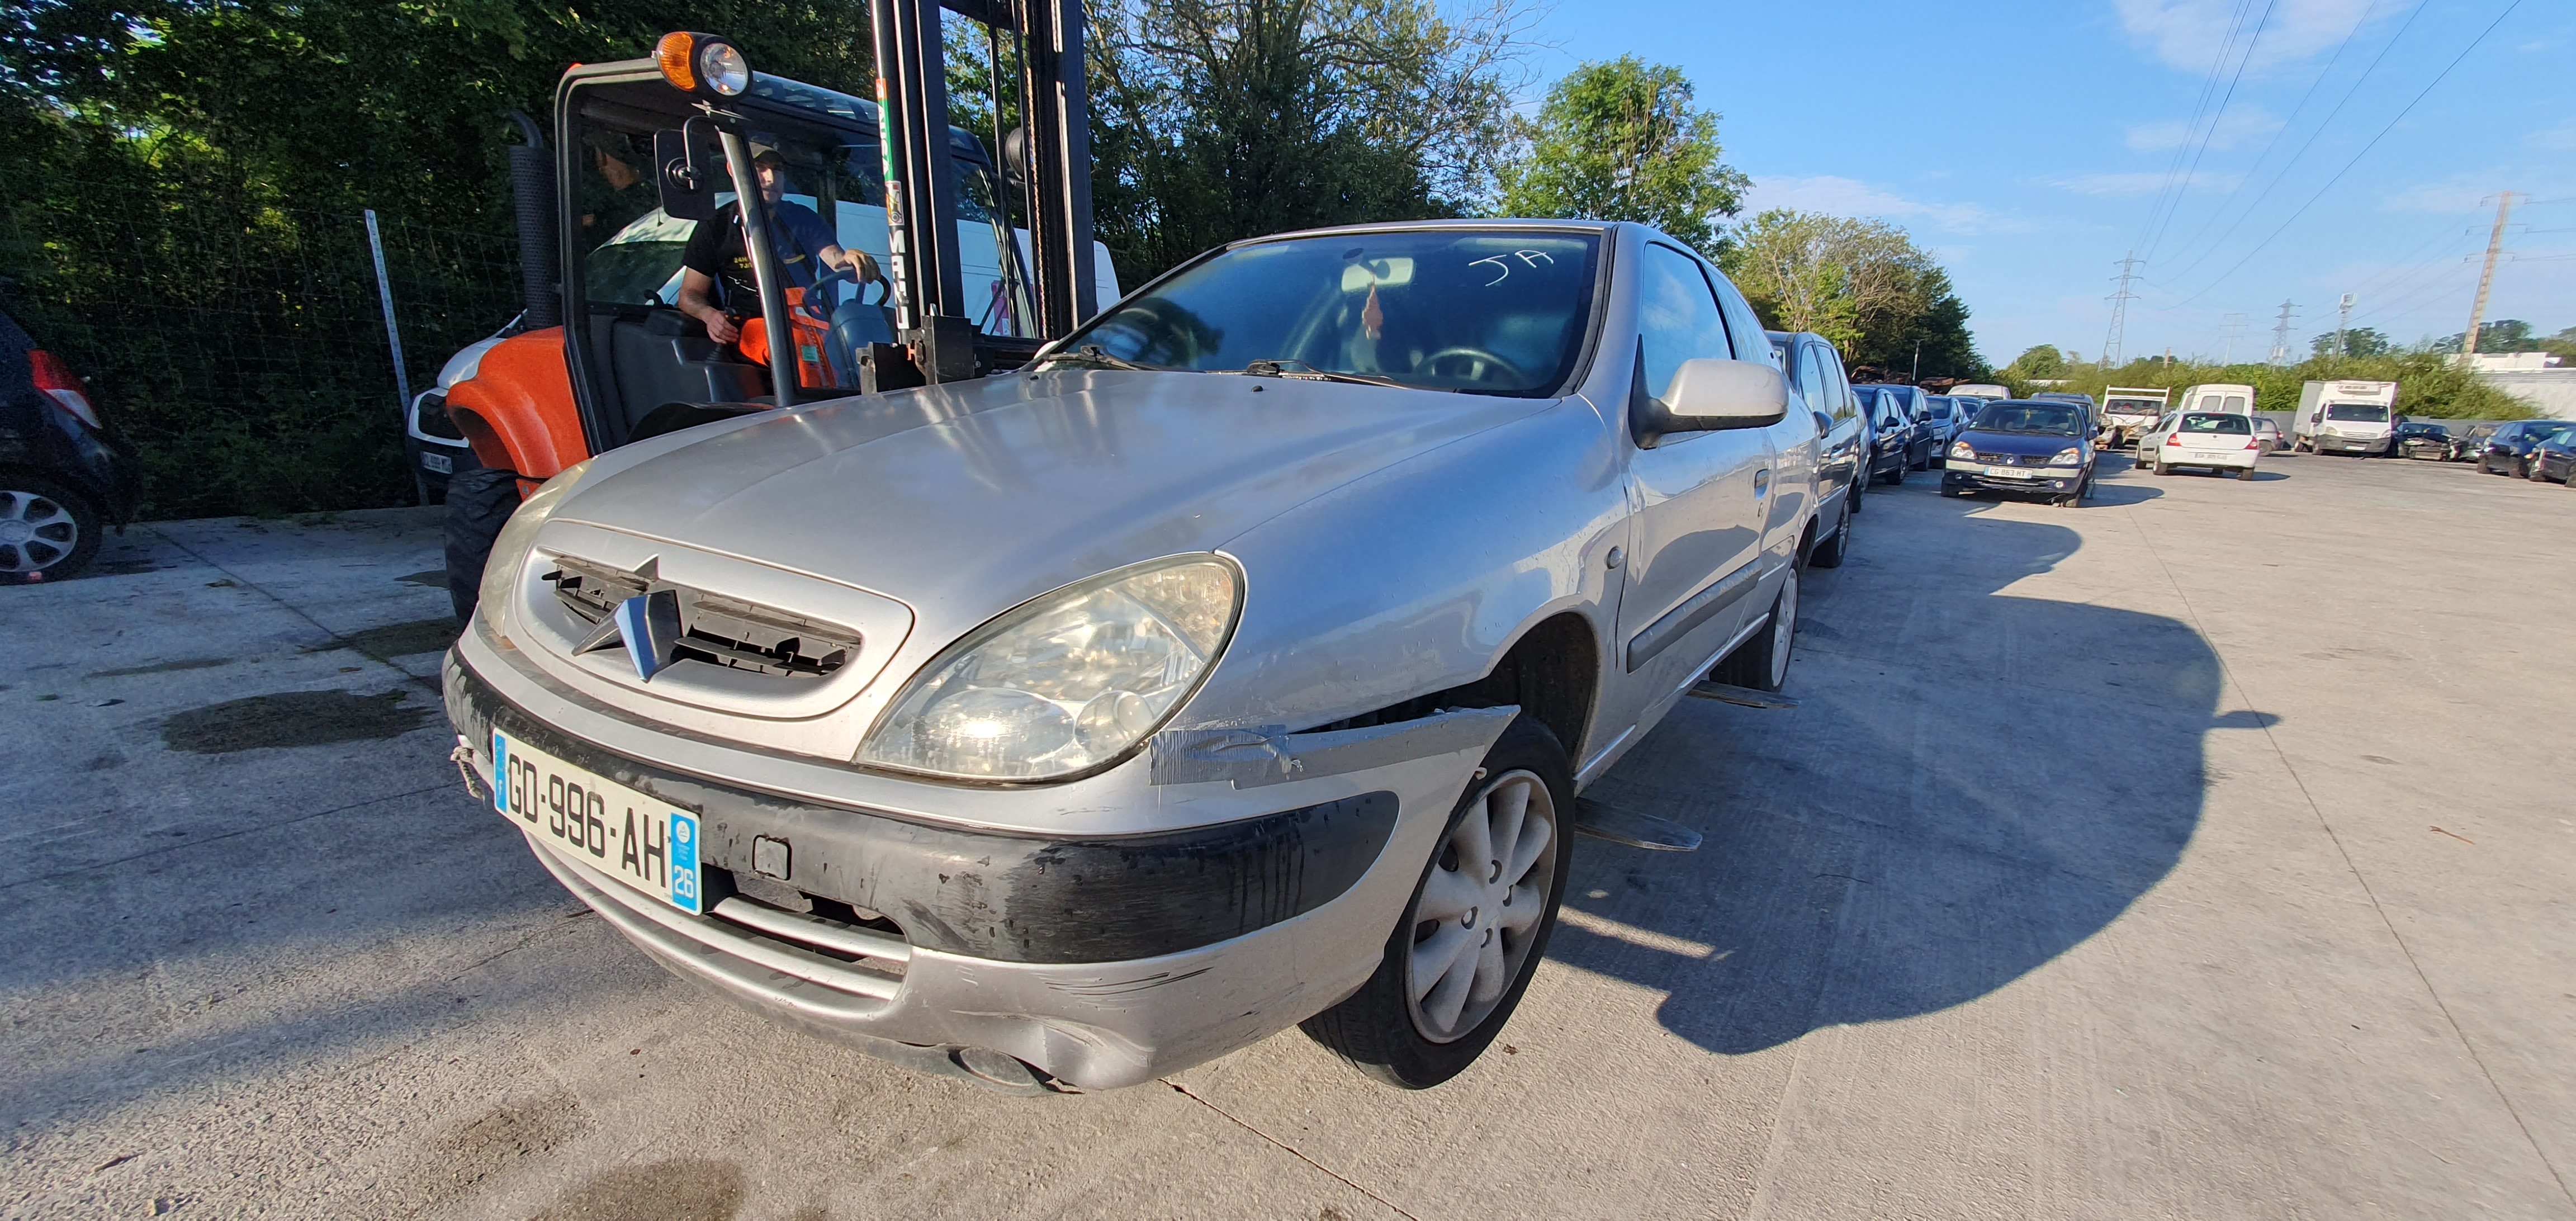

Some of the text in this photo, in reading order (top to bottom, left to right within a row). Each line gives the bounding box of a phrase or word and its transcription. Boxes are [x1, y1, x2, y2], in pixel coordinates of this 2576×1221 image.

[888, 229, 910, 344] MANU
[509, 753, 667, 888] GD-996-AH
[674, 865, 694, 899] 26
